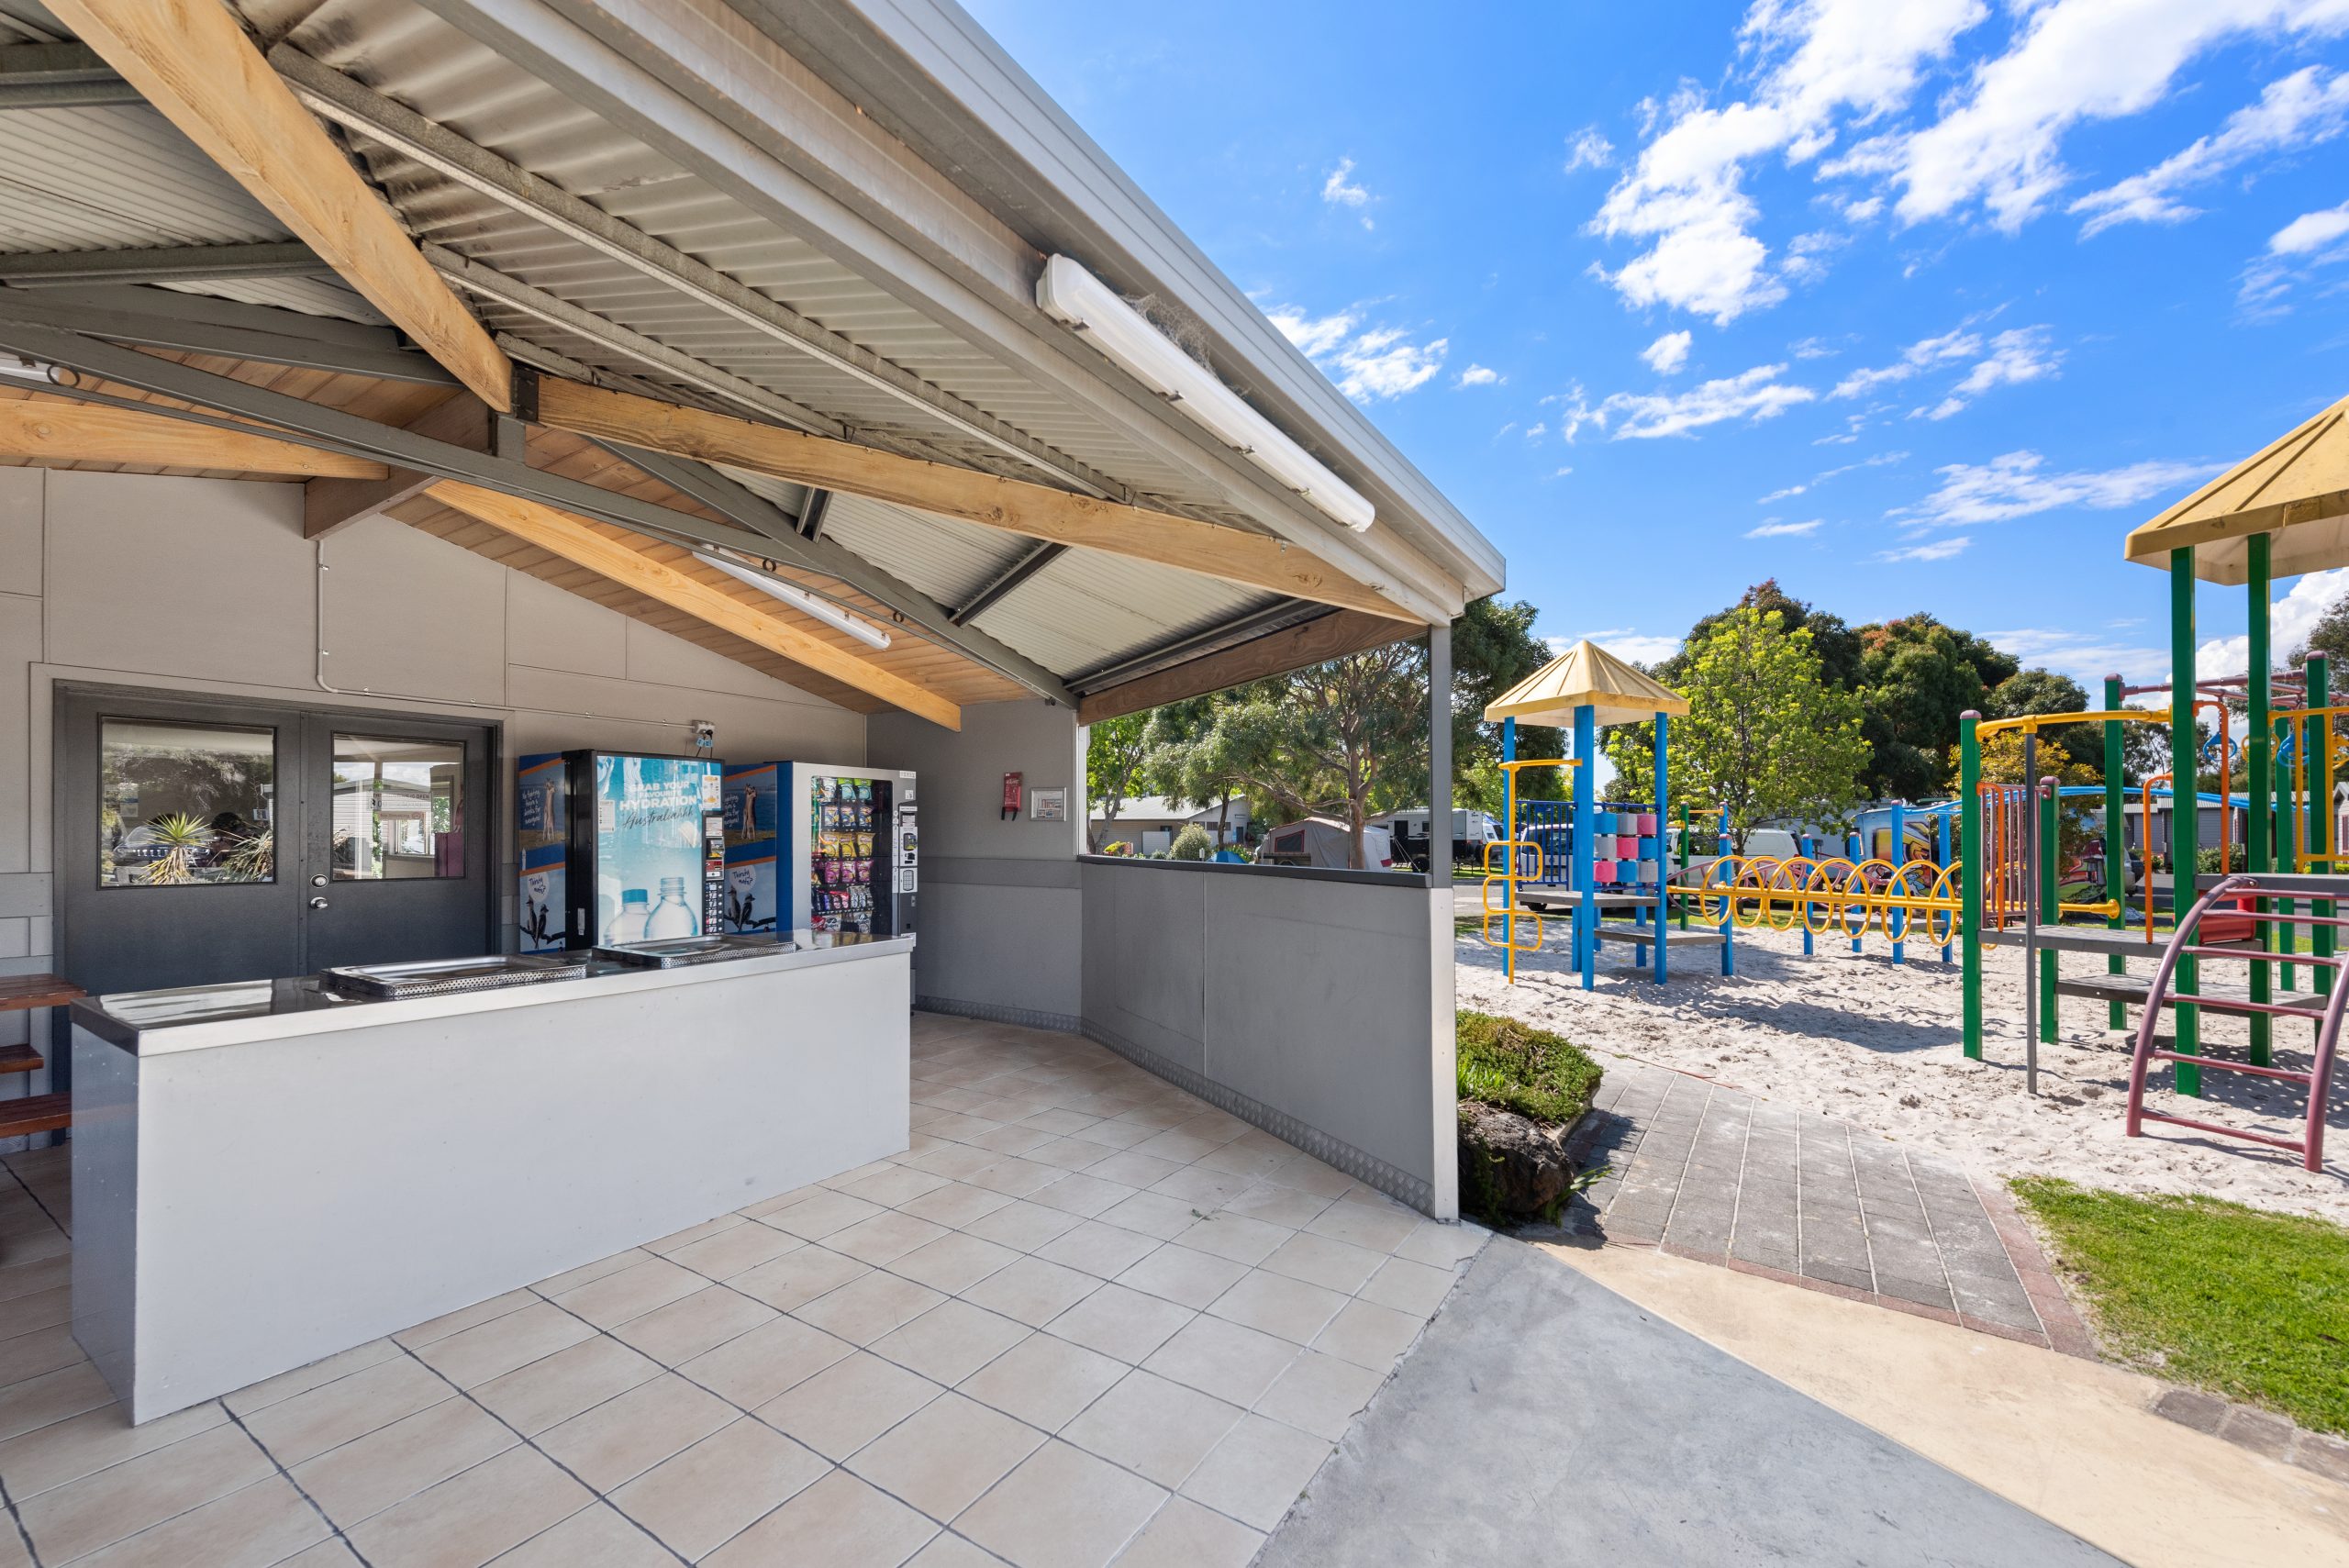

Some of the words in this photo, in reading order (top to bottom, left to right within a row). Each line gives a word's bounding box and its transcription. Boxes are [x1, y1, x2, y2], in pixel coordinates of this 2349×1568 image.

[630, 783, 661, 793] GRAB
[663, 781, 690, 790] YOUR
[619, 795, 696, 810] HYDRATION
